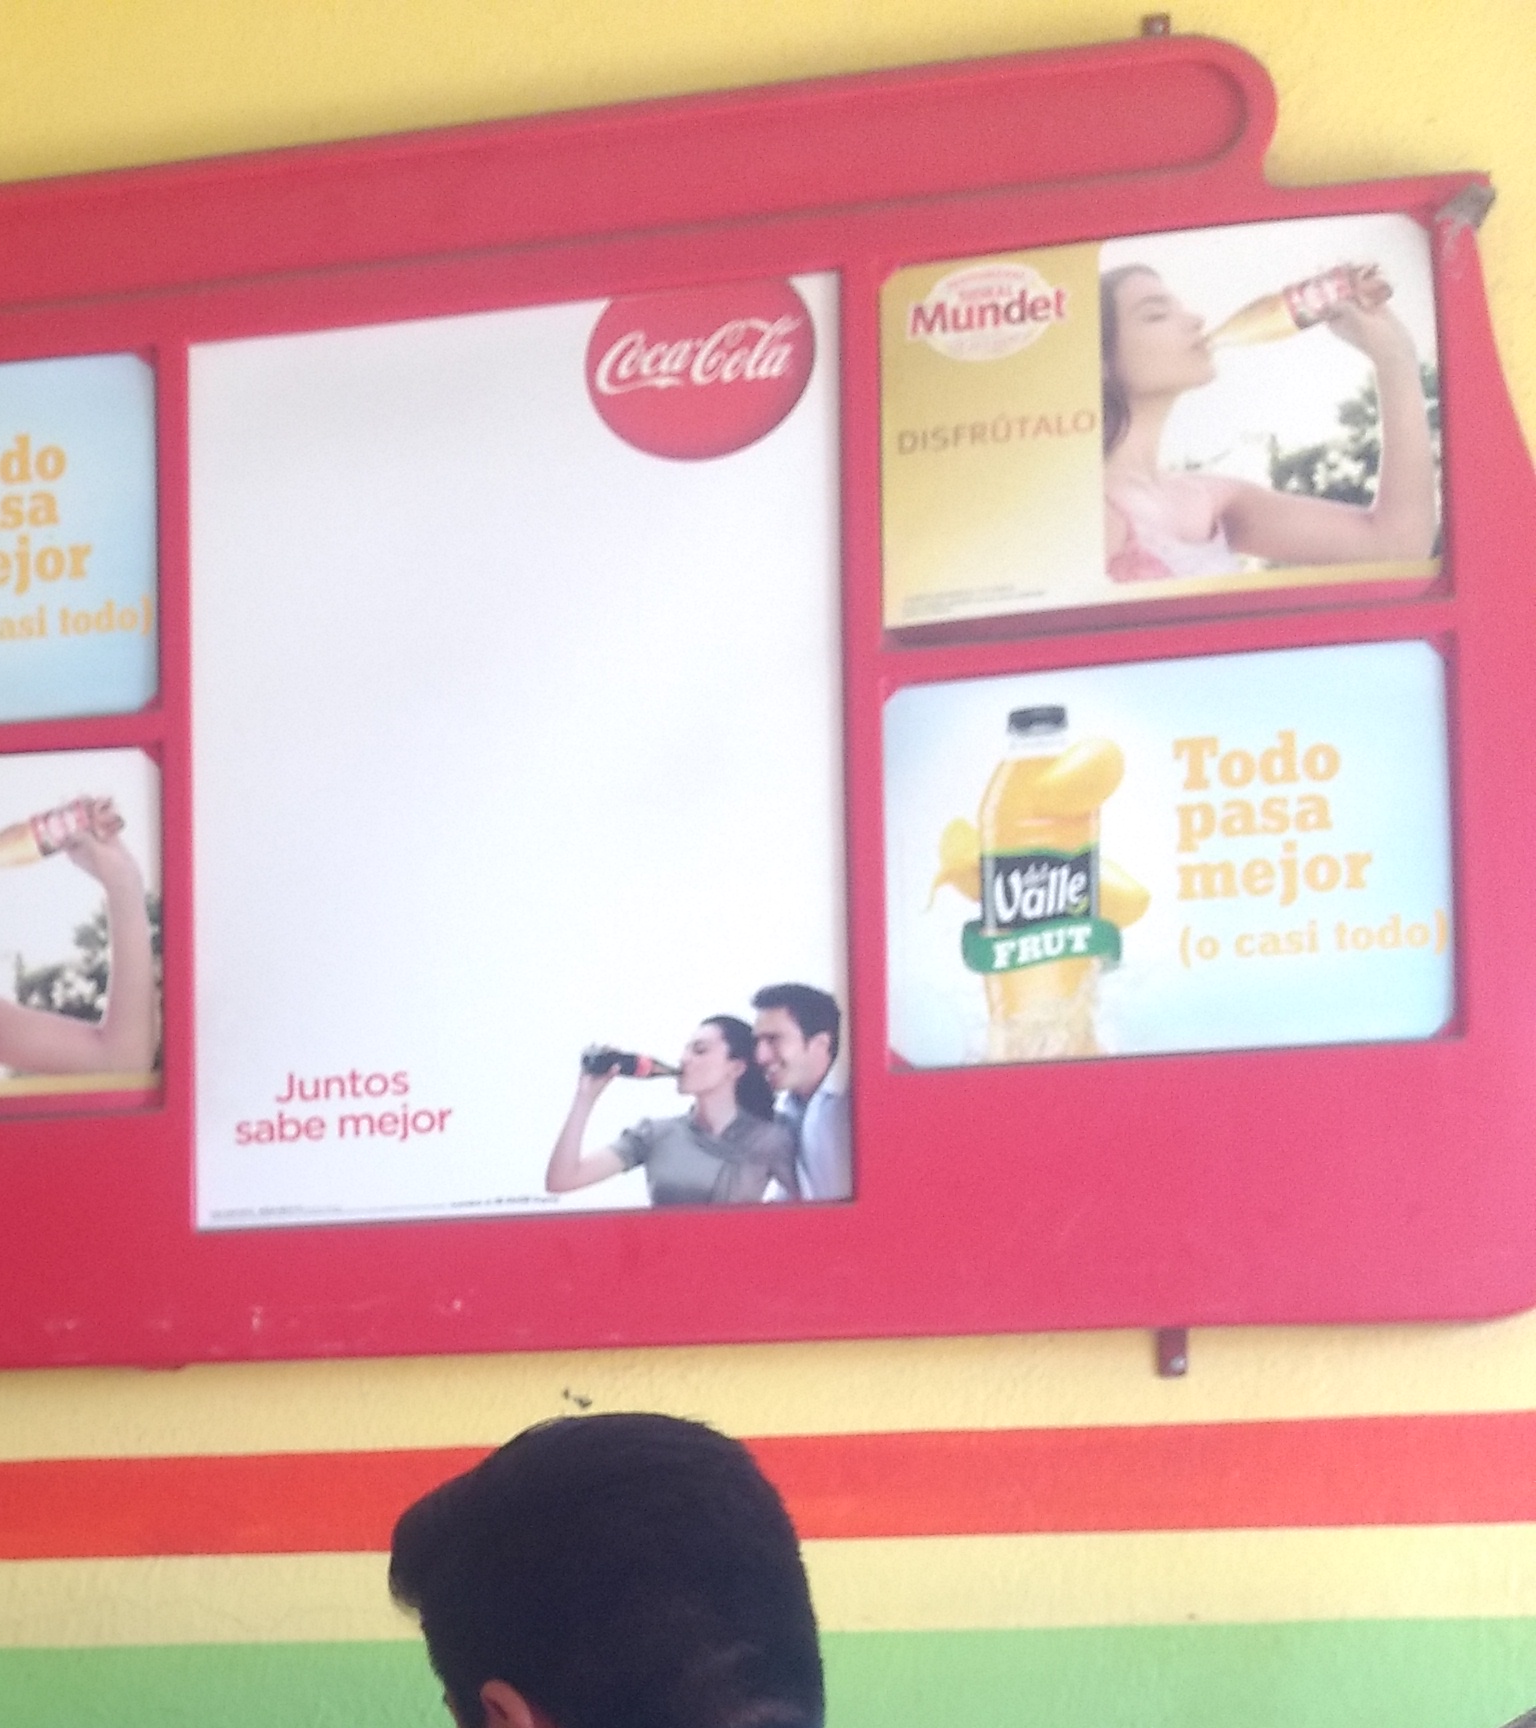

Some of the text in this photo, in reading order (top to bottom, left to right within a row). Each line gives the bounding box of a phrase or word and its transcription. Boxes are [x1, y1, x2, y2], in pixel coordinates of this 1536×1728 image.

[910, 288, 1066, 336] Mundet
[58, 595, 152, 639] todo)
[1173, 731, 1341, 793] Todo
[1176, 791, 1333, 854] pasa
[994, 864, 1087, 924] Valle
[1177, 841, 1374, 905] mejor
[992, 923, 1092, 969] FRUT
[1180, 909, 1447, 969] (o casi todo)
[276, 1068, 410, 1104] Juntos
[234, 1103, 452, 1145] sabe mejor
